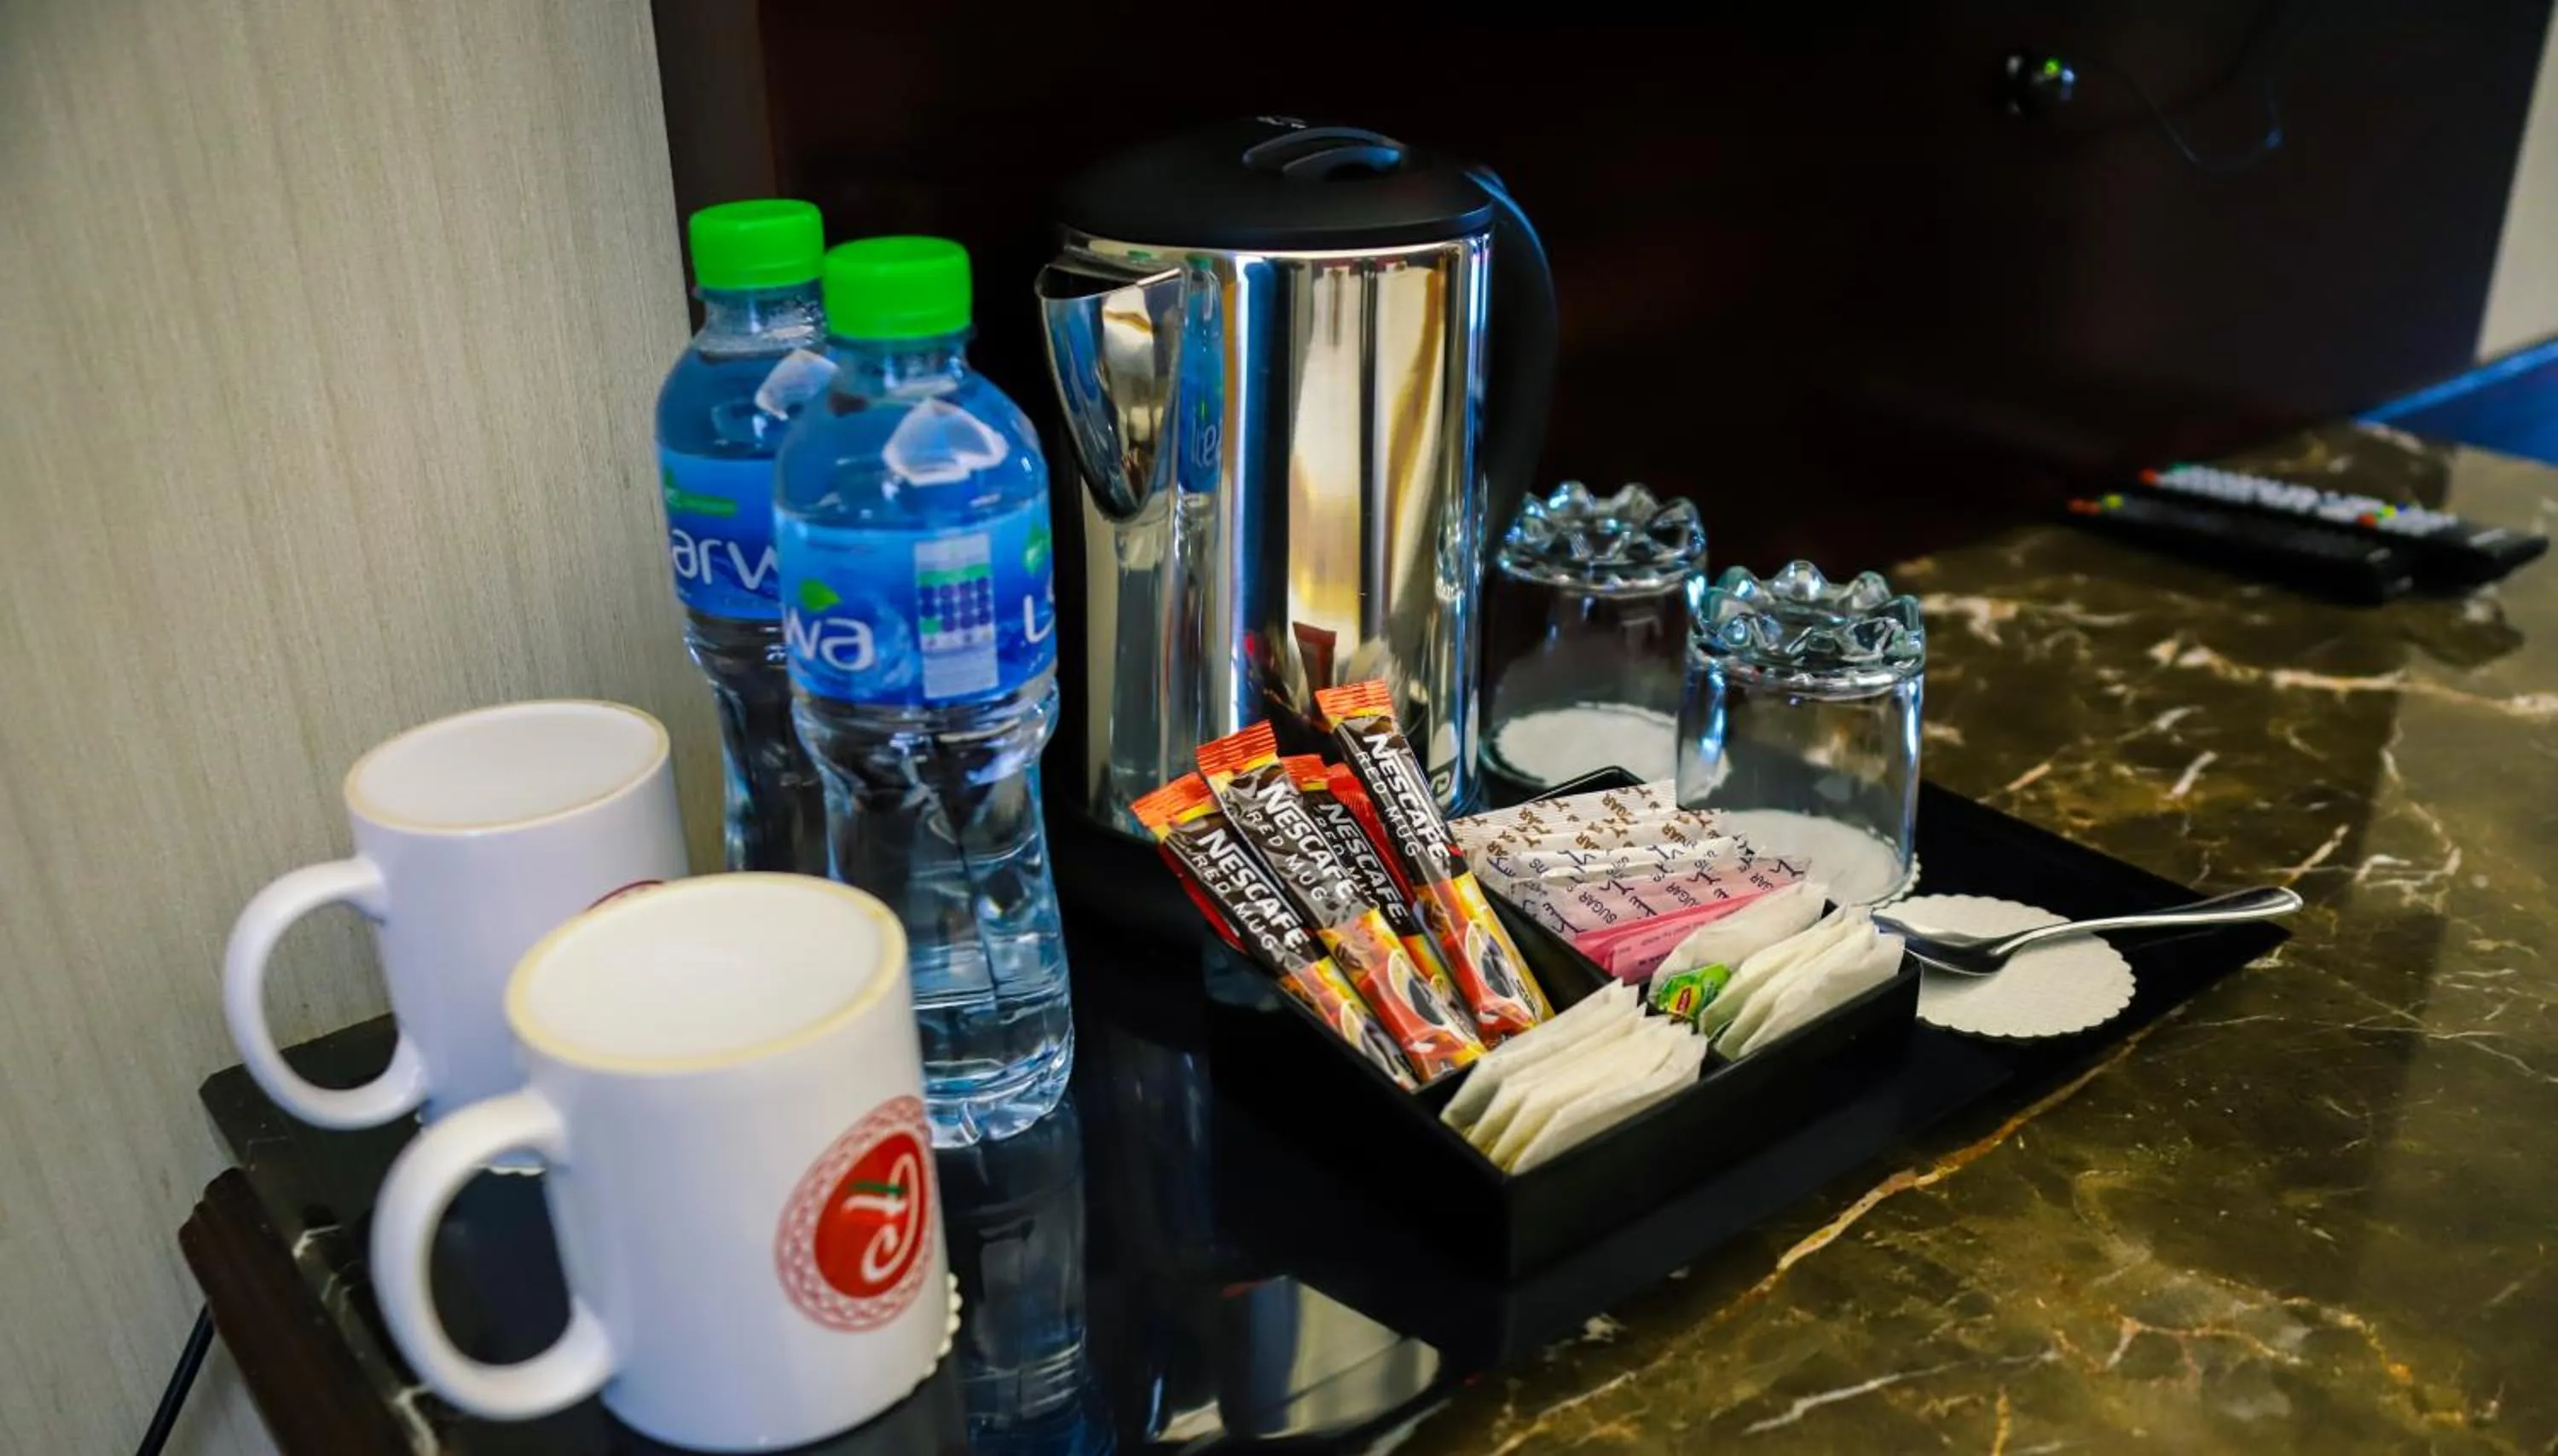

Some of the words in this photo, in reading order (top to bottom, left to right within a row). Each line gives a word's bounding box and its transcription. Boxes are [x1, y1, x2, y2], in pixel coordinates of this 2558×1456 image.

[671, 528, 779, 590] arw
[781, 605, 874, 673] wa
[1356, 750, 1387, 794] RED
[1384, 805, 1421, 858] MUG
[1247, 811, 1284, 847] RED
[1286, 852, 1328, 902] MUG
[1192, 855, 1232, 894] RED
[1233, 901, 1278, 950] MUG
[1578, 891, 1618, 925] SUGAR
[1665, 881, 1700, 906] UGAR
